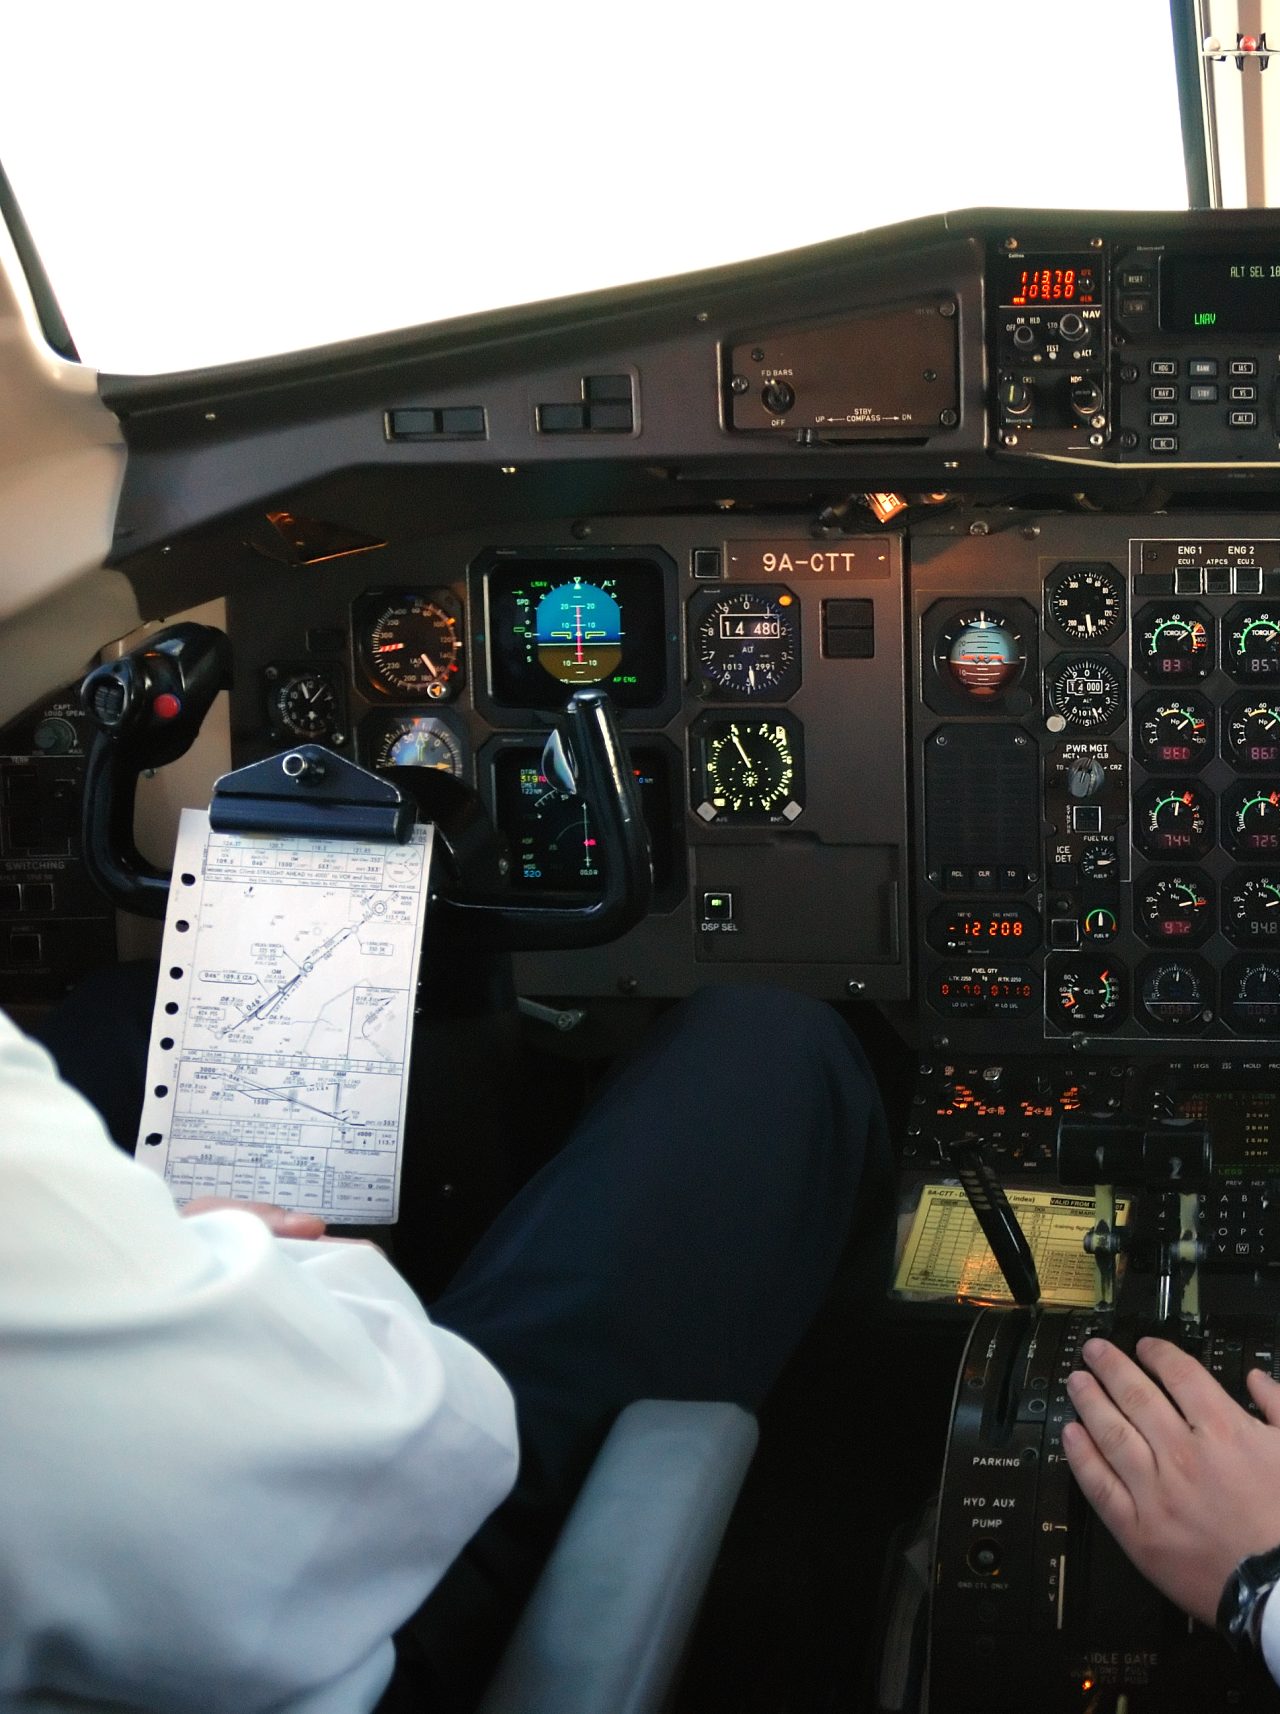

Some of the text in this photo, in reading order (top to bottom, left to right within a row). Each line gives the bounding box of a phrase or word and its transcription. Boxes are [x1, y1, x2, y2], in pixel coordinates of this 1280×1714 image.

[1230, 265, 1245, 277] ALT
[1249, 265, 1265, 277] SEL
[1082, 310, 1101, 319] NAV
[1194, 313, 1216, 326] LNAV
[1081, 349, 1092, 357] ACT
[773, 368, 793, 376] BARS
[771, 419, 785, 427] OFF
[1178, 546, 1196, 554] ENG
[1228, 546, 1255, 554] ENG 2
[762, 553, 855, 572] 9A-CTT
[724, 621, 744, 636] 14
[722, 663, 743, 671] 1013
[1066, 744, 1108, 752] PWR MGT
[1056, 846, 1070, 854] ICE
[1055, 855, 1072, 863] DET
[5, 861, 65, 870] SWITCHING
[701, 923, 738, 931] DSP SEL
[989, 922, 1022, 936] 208
[1050, 1198, 1070, 1207] VALID
[972, 1457, 1021, 1467] PARKING
[963, 1498, 1016, 1508] HYD AUX
[971, 1518, 1003, 1528] PUMP
